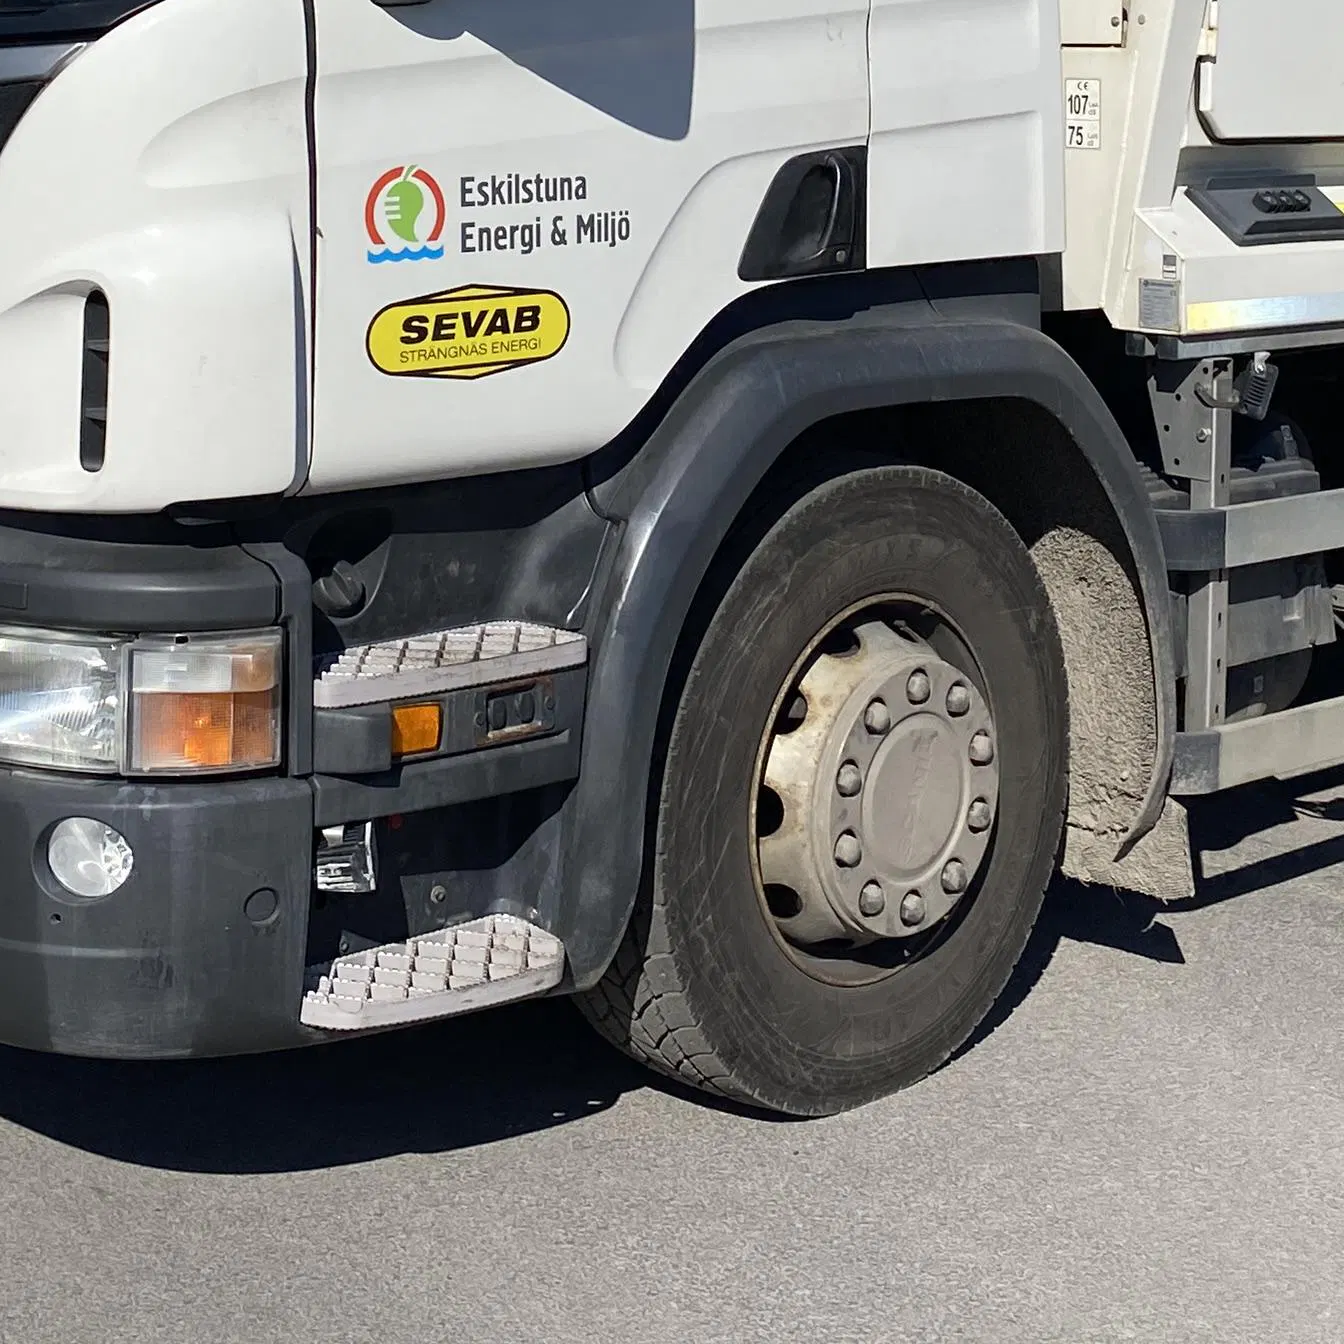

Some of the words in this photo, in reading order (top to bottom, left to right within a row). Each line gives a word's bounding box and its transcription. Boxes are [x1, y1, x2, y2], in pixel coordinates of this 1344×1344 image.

[1068, 94, 1089, 115] 107
[1068, 125, 1084, 145] 75
[460, 173, 587, 207] Eskilstuna
[460, 217, 542, 254] Energi
[551, 215, 568, 247] &
[576, 211, 630, 248] Miljö
[400, 305, 542, 345] SEVAB
[400, 342, 488, 364] STRÄNGNÄS
[491, 338, 542, 354] ENERGI
